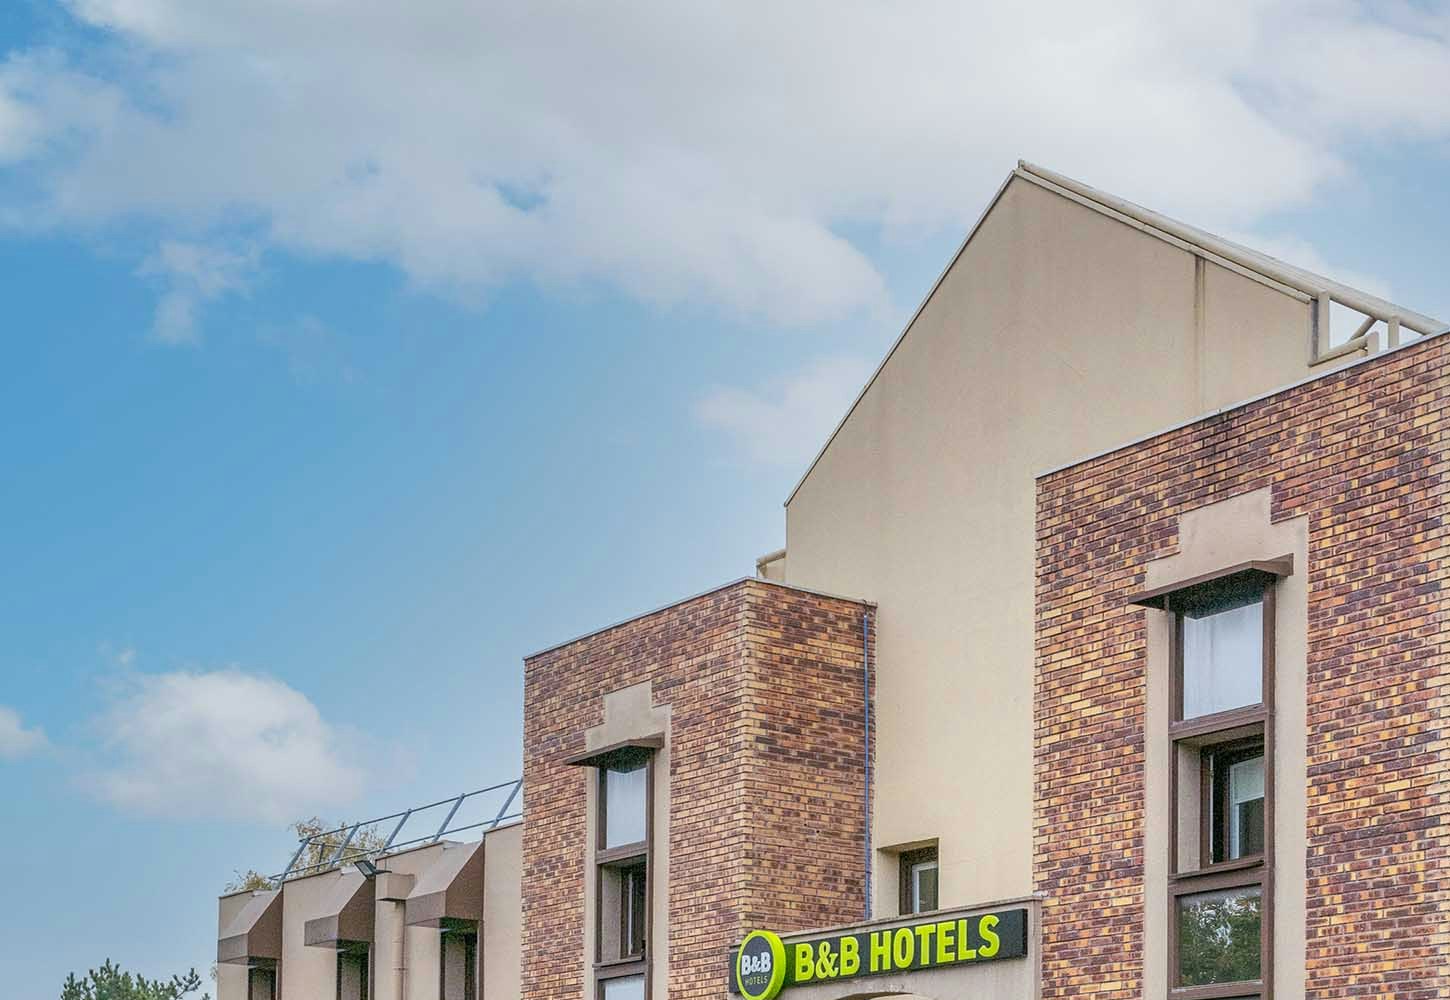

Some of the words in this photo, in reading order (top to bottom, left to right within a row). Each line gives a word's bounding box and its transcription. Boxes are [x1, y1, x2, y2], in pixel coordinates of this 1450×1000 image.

[794, 936, 861, 982] B&B
[870, 914, 1001, 973] HOTELS
[741, 951, 772, 976] B&B
[744, 975, 769, 987] HOTELS
